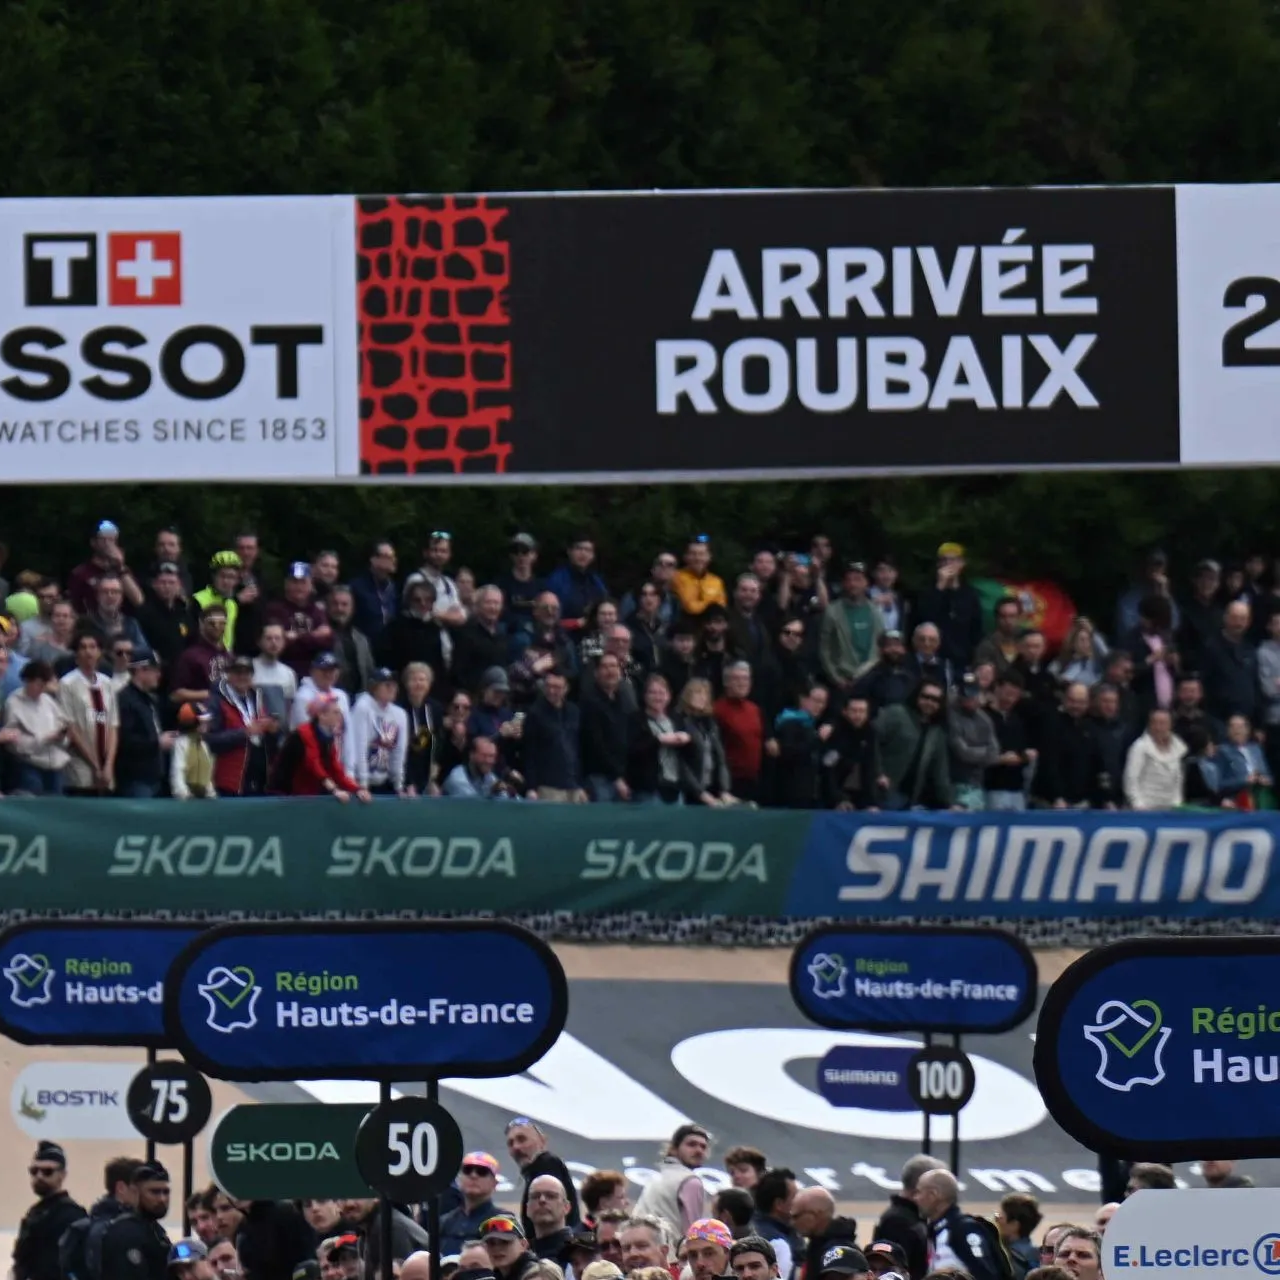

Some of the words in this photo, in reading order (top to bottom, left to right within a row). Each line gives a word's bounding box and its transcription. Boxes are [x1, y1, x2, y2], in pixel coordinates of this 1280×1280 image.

[692, 228, 1098, 320] ARRIVÉE
[655, 334, 1099, 414] ROUBAIX
[153, 419, 246, 442] SINCE
[259, 418, 326, 441] 1853
[838, 825, 1274, 904] SHIMANO
[65, 957, 132, 978] Région
[276, 970, 359, 994] Région
[855, 977, 1019, 1001] Hauts-de-France
[276, 998, 535, 1028] Hauts-de-France
[823, 1068, 899, 1086] SHIMANO
[916, 1061, 965, 1099] 100
[37, 1088, 119, 1107] BOSTIK
[150, 1080, 190, 1123] 75
[227, 1142, 340, 1161] SKODA
[387, 1122, 439, 1176] 50
[1113, 1245, 1250, 1268] E.Leclerc
